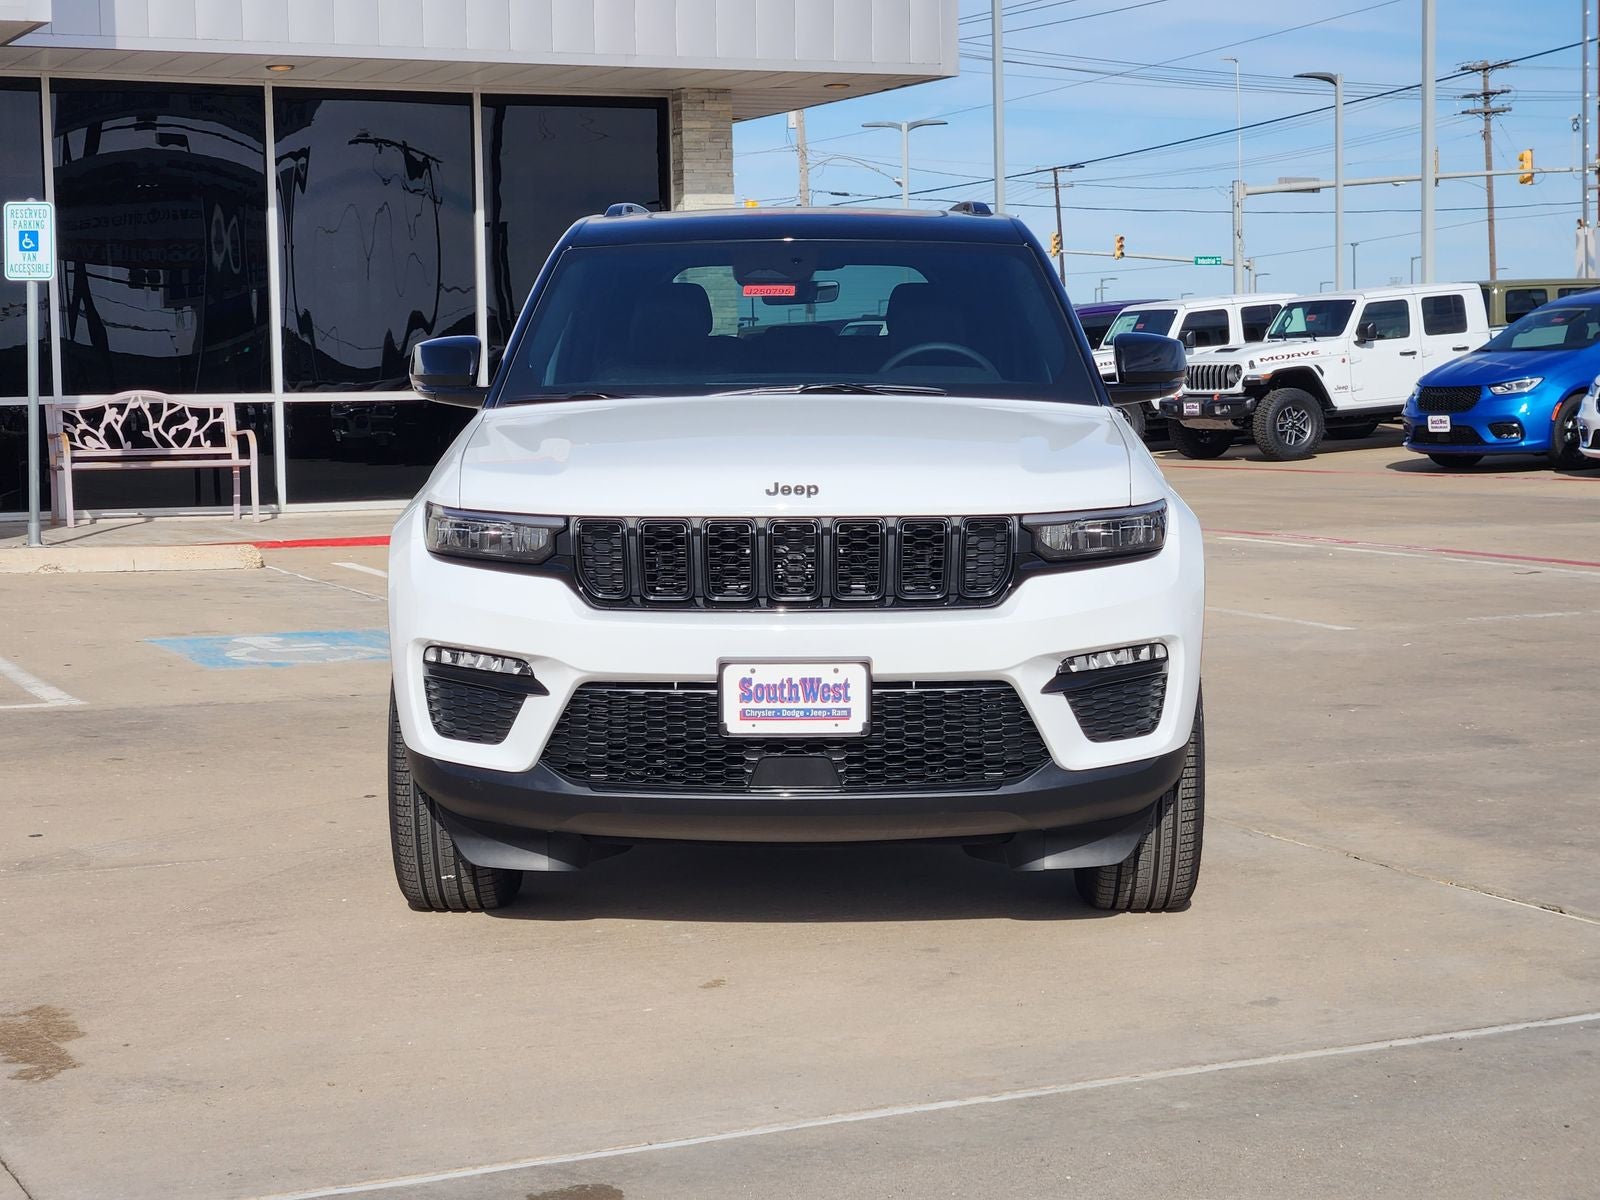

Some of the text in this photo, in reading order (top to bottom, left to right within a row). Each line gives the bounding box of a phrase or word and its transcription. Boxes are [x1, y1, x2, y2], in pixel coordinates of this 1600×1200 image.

[10, 208, 48, 219] RESERVED
[12, 219, 45, 230] PARKING
[22, 252, 37, 262] VAN
[9, 263, 50, 273] ACCESSIBLE
[1259, 349, 1320, 362] MOJAVE
[765, 481, 819, 499] Jeep
[739, 677, 852, 704] SouthWest
[745, 709, 848, 718] Chrysler Dodge Jeep Ram
